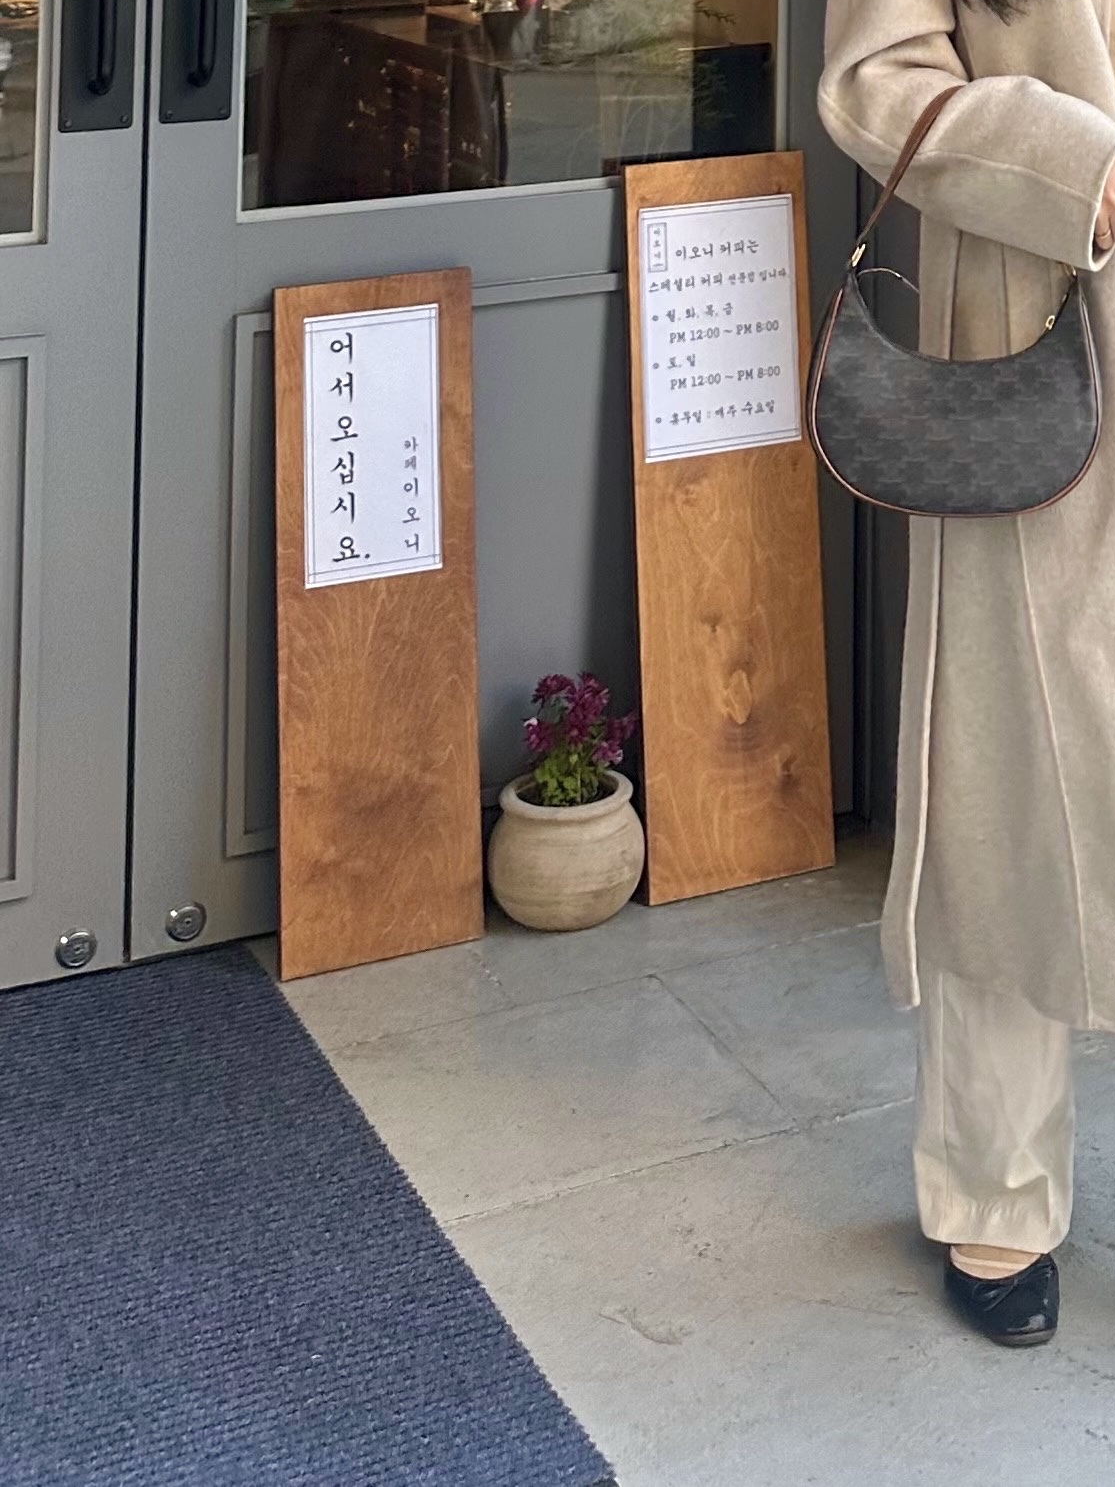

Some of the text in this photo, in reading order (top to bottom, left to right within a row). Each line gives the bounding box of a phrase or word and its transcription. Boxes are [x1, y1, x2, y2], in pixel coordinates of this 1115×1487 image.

[675, 239, 760, 261] 이오니 커피는
[700, 271, 723, 287] 커피
[722, 302, 734, 316] 금
[669, 331, 686, 344] PM
[690, 327, 720, 342] 12:00
[736, 323, 752, 336] PM
[755, 319, 780, 333] 8:00
[686, 353, 696, 368] 일
[670, 377, 687, 390] PM
[691, 372, 722, 388] 12:00
[737, 368, 753, 382] PM
[757, 365, 781, 379] 8:00
[669, 409, 702, 426] 휴무일
[741, 399, 775, 416] 수요일
[329, 332, 371, 563] 어서오십시요.
